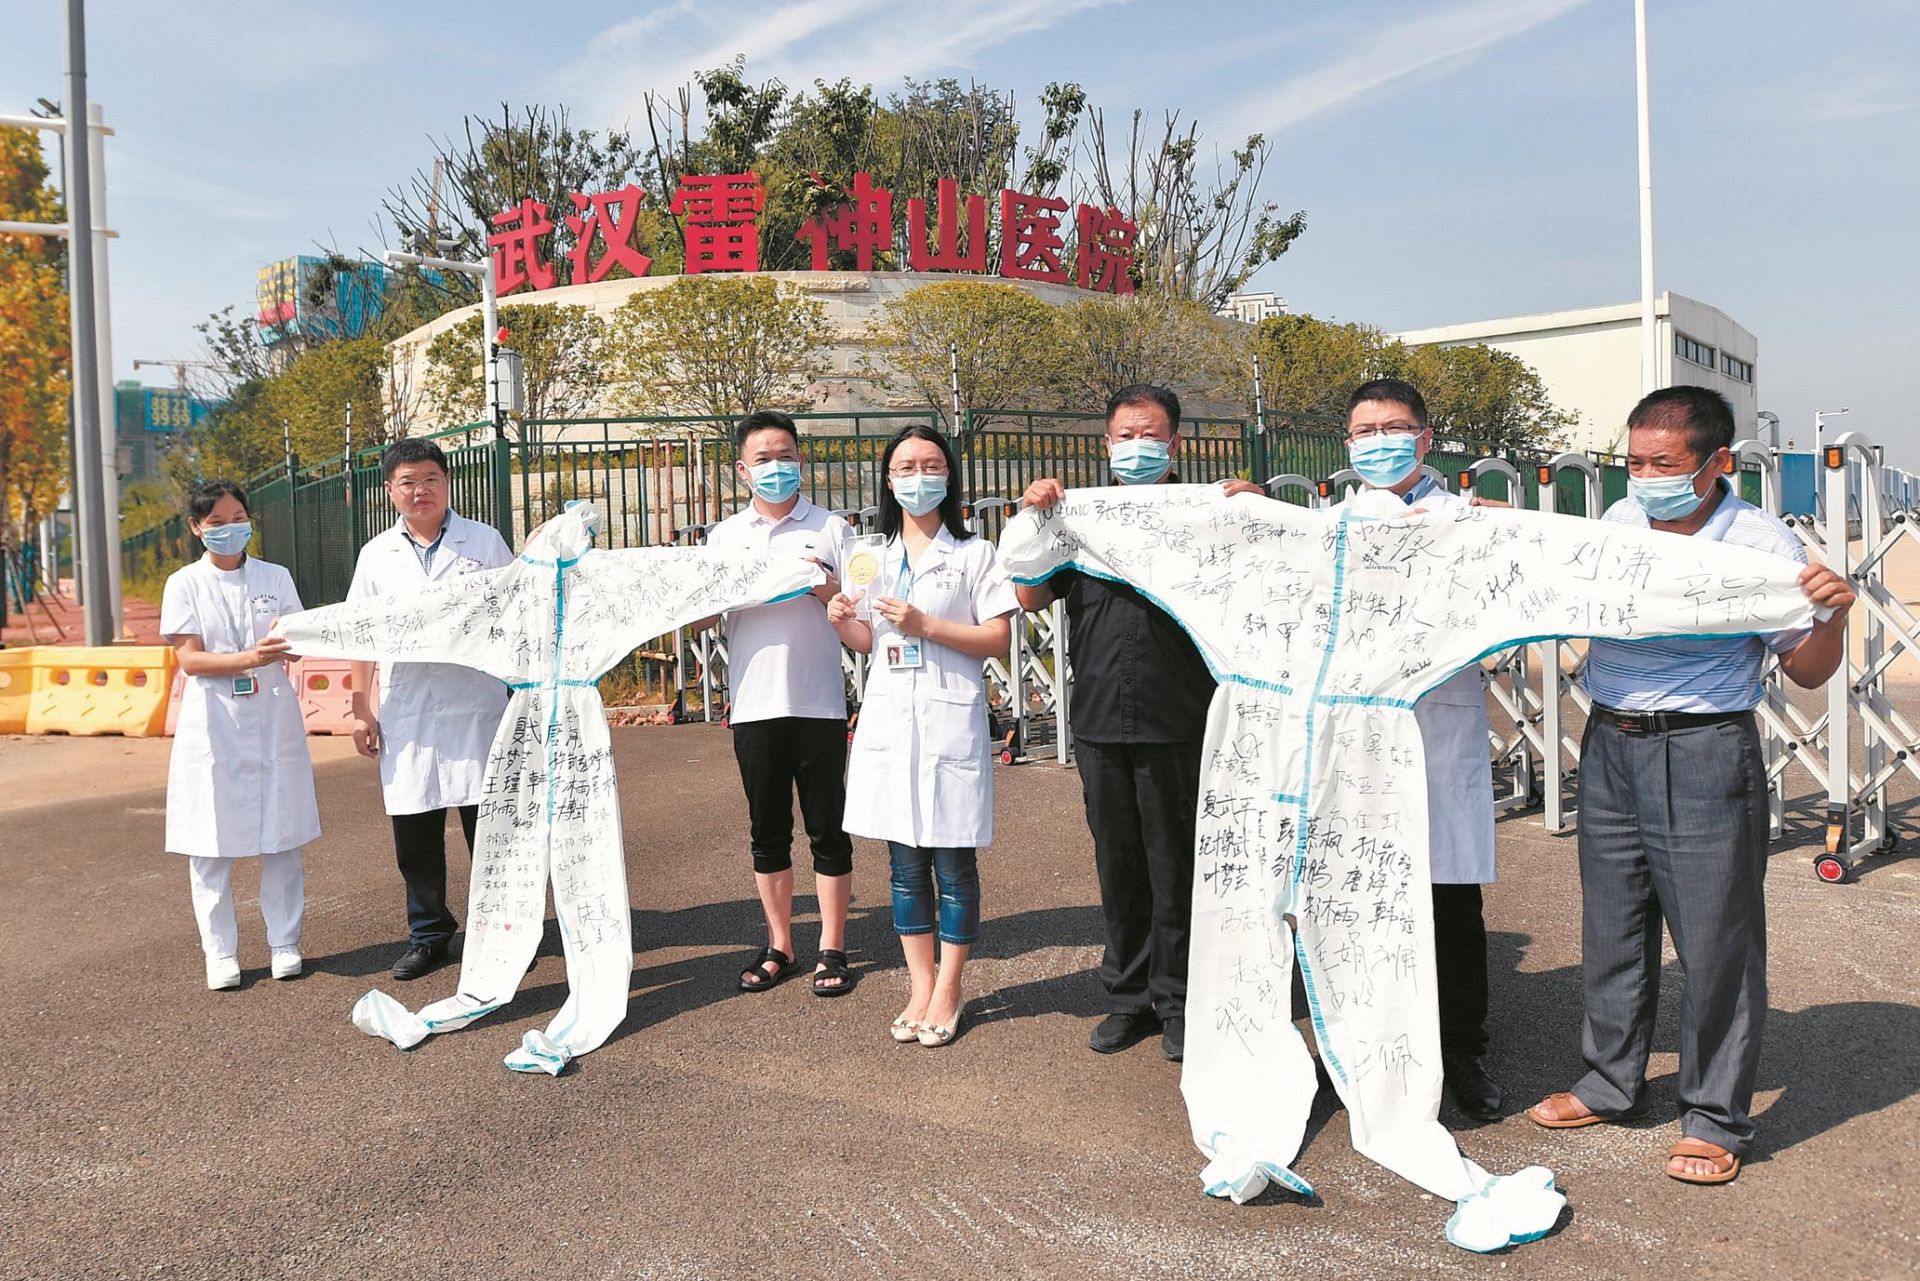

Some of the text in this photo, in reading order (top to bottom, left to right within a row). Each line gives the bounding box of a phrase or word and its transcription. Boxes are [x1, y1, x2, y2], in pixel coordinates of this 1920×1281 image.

[487, 171, 1139, 295] 武汉雷神山医院
